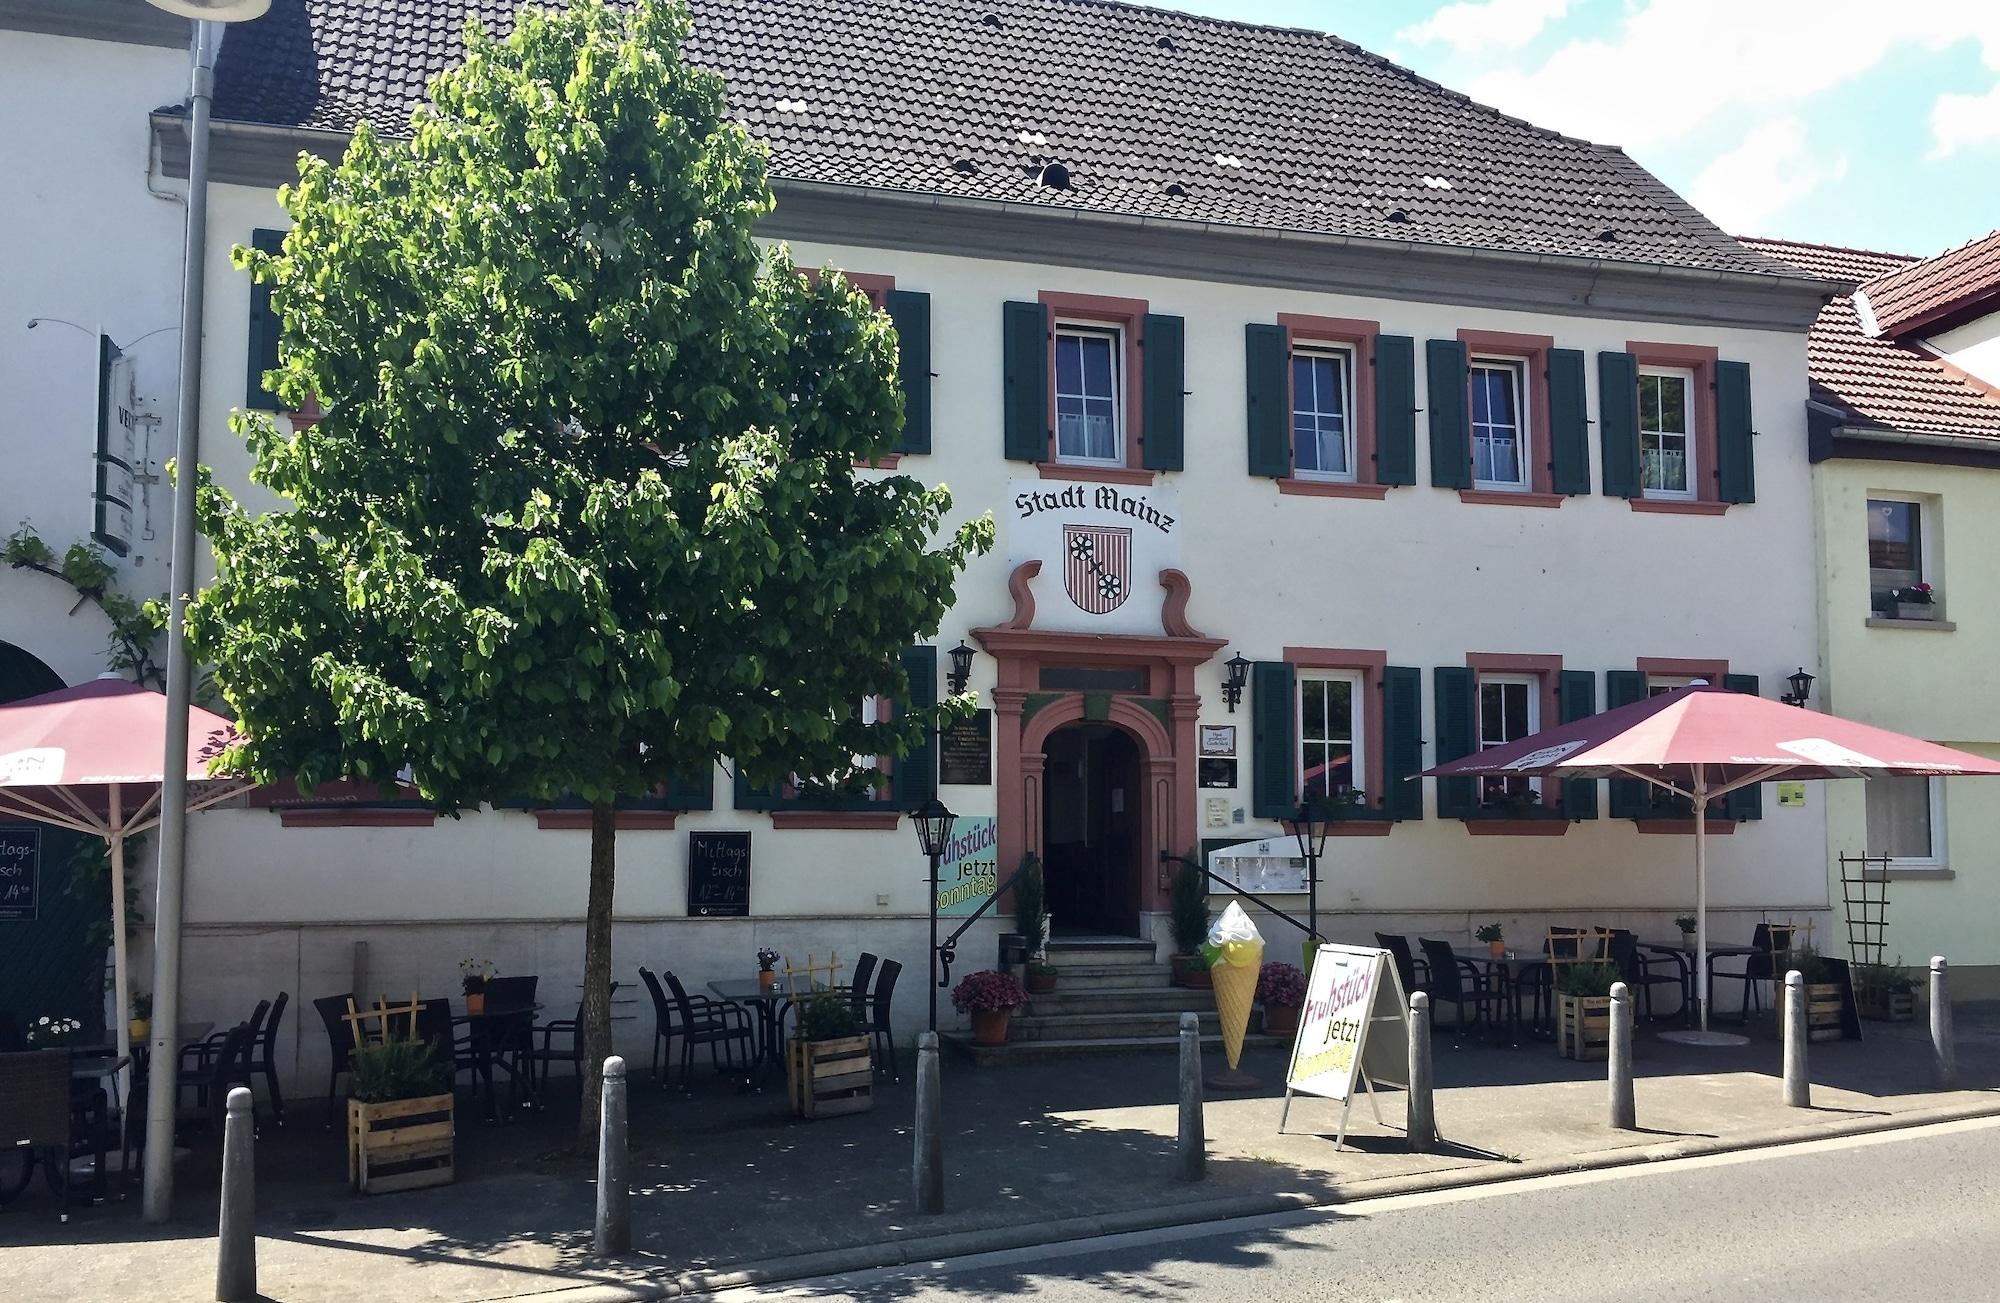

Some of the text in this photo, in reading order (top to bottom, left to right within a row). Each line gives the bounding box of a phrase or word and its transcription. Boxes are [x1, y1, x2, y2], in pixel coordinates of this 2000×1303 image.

[1015, 485, 1175, 533] Stadt Mainz
[938, 817, 996, 868] ühstück
[711, 862, 742, 878] tisch
[957, 857, 996, 881] jetzt
[1323, 1012, 1361, 1045] jetzt
